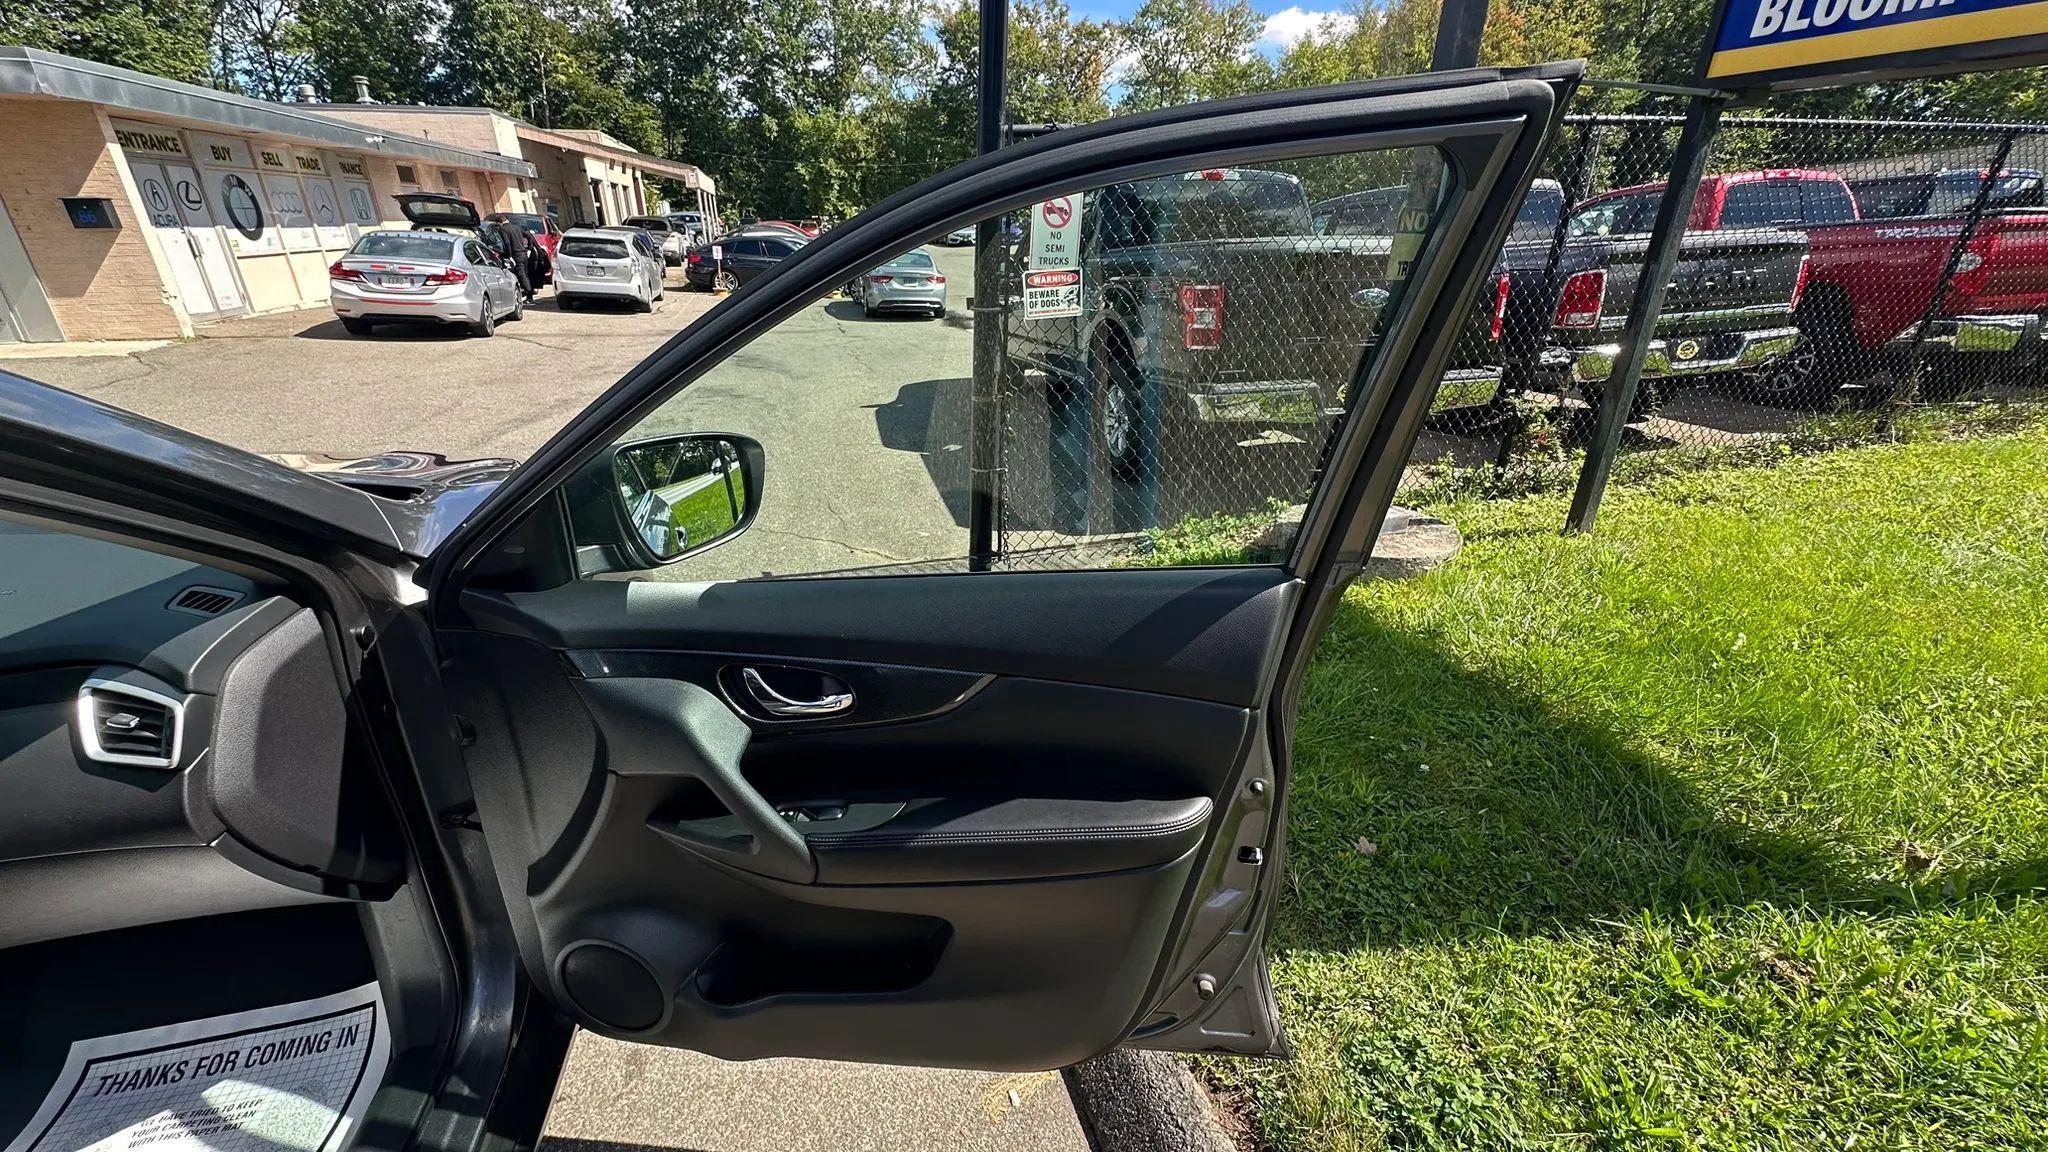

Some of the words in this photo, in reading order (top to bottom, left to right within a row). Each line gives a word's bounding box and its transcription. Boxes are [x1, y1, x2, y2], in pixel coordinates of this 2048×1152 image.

[117, 130, 182, 153] ENTRANCE
[210, 145, 232, 162] BUY
[261, 151, 284, 167] SELL
[295, 156, 321, 171] TRADE
[153, 214, 179, 228] ACURA
[1400, 210, 1429, 231] NO
[1050, 231, 1062, 240] NO
[1045, 244, 1065, 253] SEMI
[1038, 256, 1069, 266] TRUCKS
[1033, 274, 1073, 284] WARNING
[1029, 289, 1060, 299] BEWARE
[1029, 300, 1039, 309] OF
[1040, 299, 1061, 308] DOGS
[94, 1061, 187, 1097] THANKS
[192, 1051, 239, 1080] FOR
[243, 1030, 332, 1069] COMING
[336, 1024, 361, 1050] IN
[159, 1110, 187, 1124] HAVE
[189, 1107, 221, 1118] TRIED
[220, 1103, 235, 1112] TO
[236, 1098, 263, 1110] KEEP
[132, 1125, 159, 1138] YOUR
[162, 1117, 221, 1131] CARPETING
[223, 1110, 257, 1122] CLEAN
[128, 1136, 155, 1149] WITH
[157, 1131, 184, 1142] THIS
[185, 1123, 221, 1137] PAPER
[221, 1121, 245, 1133] MAT
